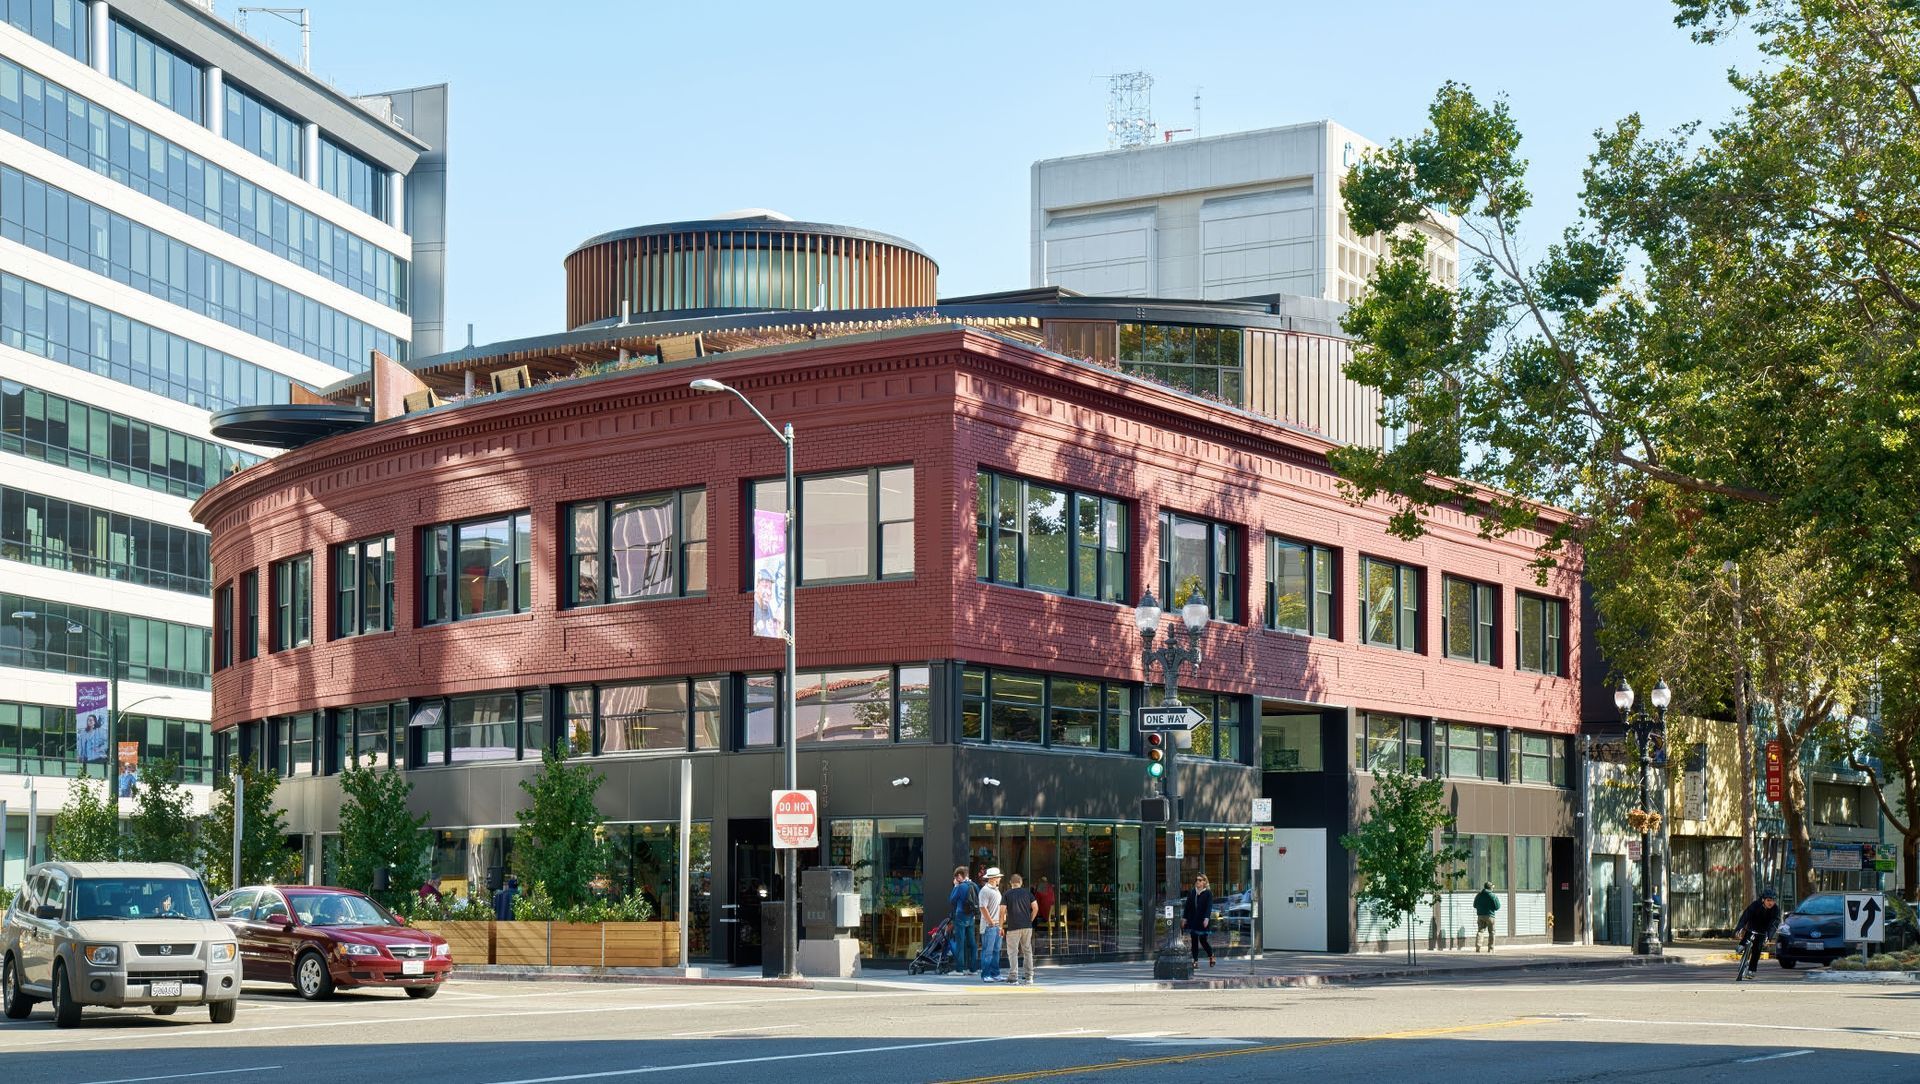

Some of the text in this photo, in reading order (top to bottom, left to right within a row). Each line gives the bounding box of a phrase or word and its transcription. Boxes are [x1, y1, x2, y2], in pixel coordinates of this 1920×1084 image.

[1146, 714, 1186, 724] ONE WAY
[779, 802, 810, 812] DO NOT
[781, 826, 809, 836] ENTER
